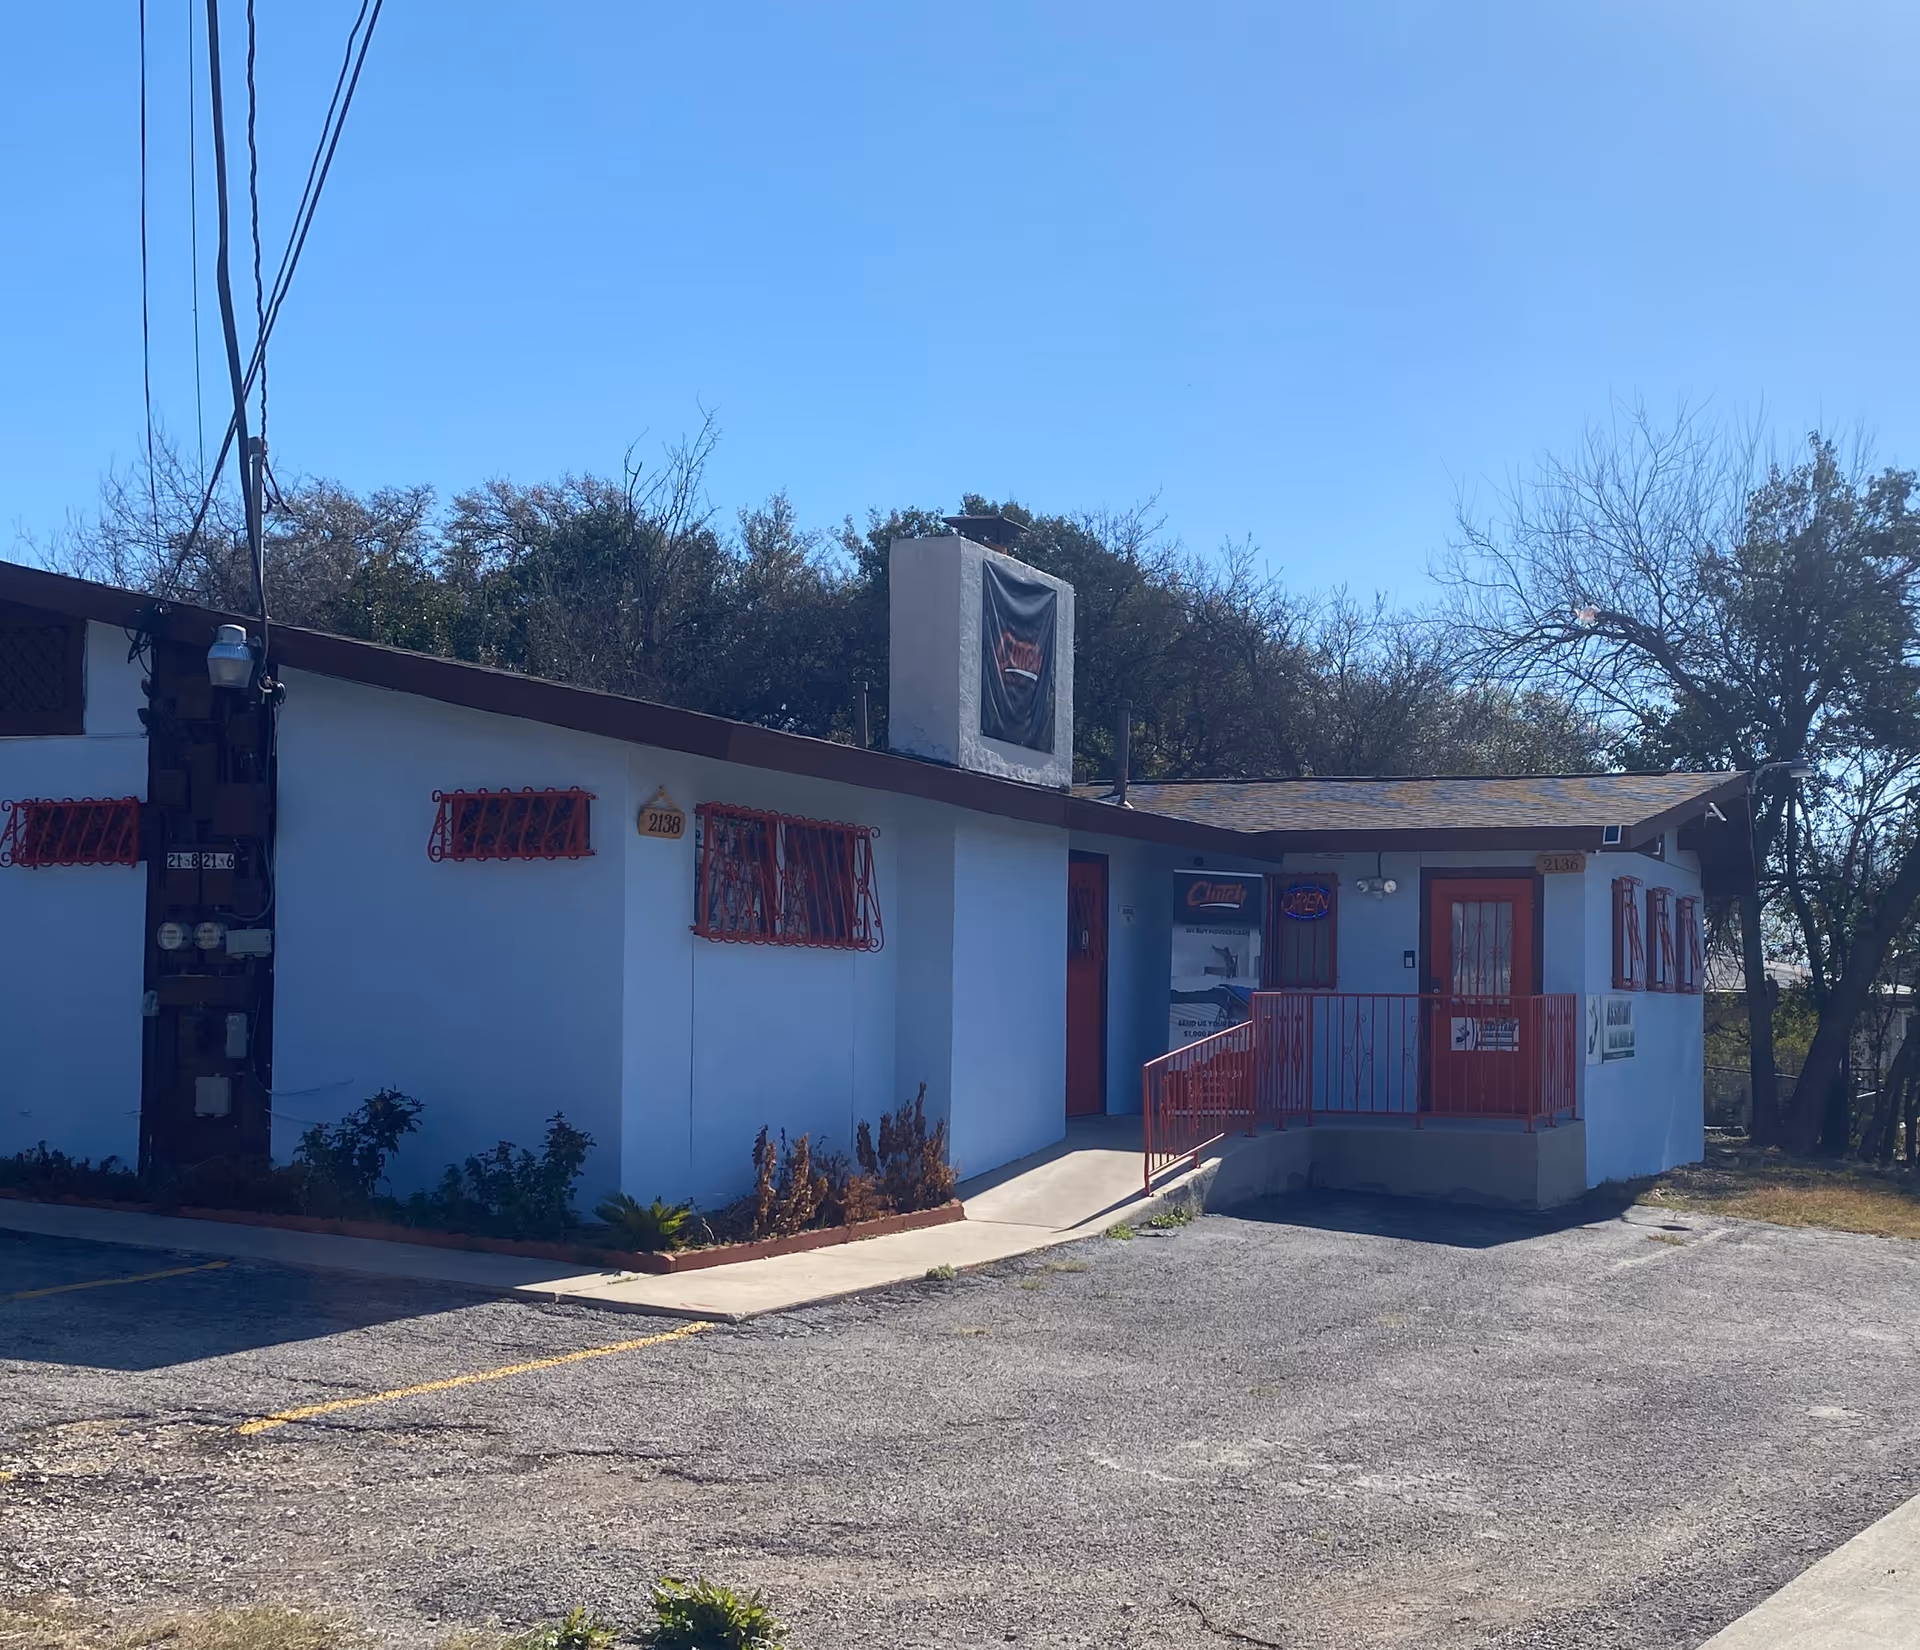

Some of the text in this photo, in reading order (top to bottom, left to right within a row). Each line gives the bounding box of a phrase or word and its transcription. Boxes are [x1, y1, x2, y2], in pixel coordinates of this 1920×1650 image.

[648, 812, 681, 835] 2138
[1543, 857, 1579, 872] 2136
[1186, 881, 1247, 908] Clutch
[1281, 891, 1330, 912] OPEN
